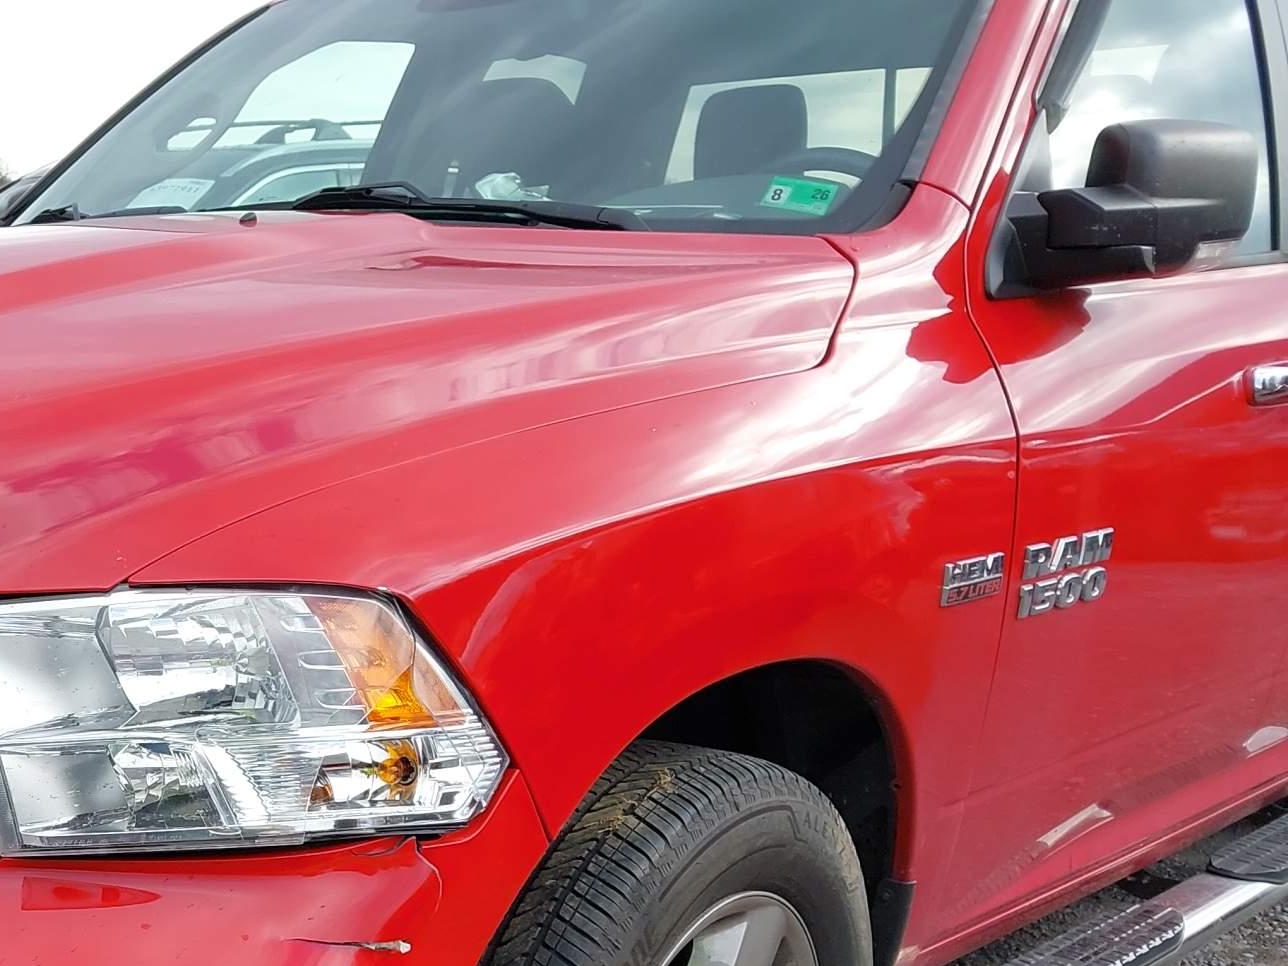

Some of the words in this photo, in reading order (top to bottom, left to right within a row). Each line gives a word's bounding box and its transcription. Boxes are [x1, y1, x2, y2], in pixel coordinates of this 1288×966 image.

[771, 188, 784, 201] 8
[811, 188, 831, 201] 26
[1022, 527, 1115, 580] RAM
[948, 587, 969, 602] 5.7
[968, 580, 1000, 598] LITER
[1017, 566, 1108, 620] 1500
